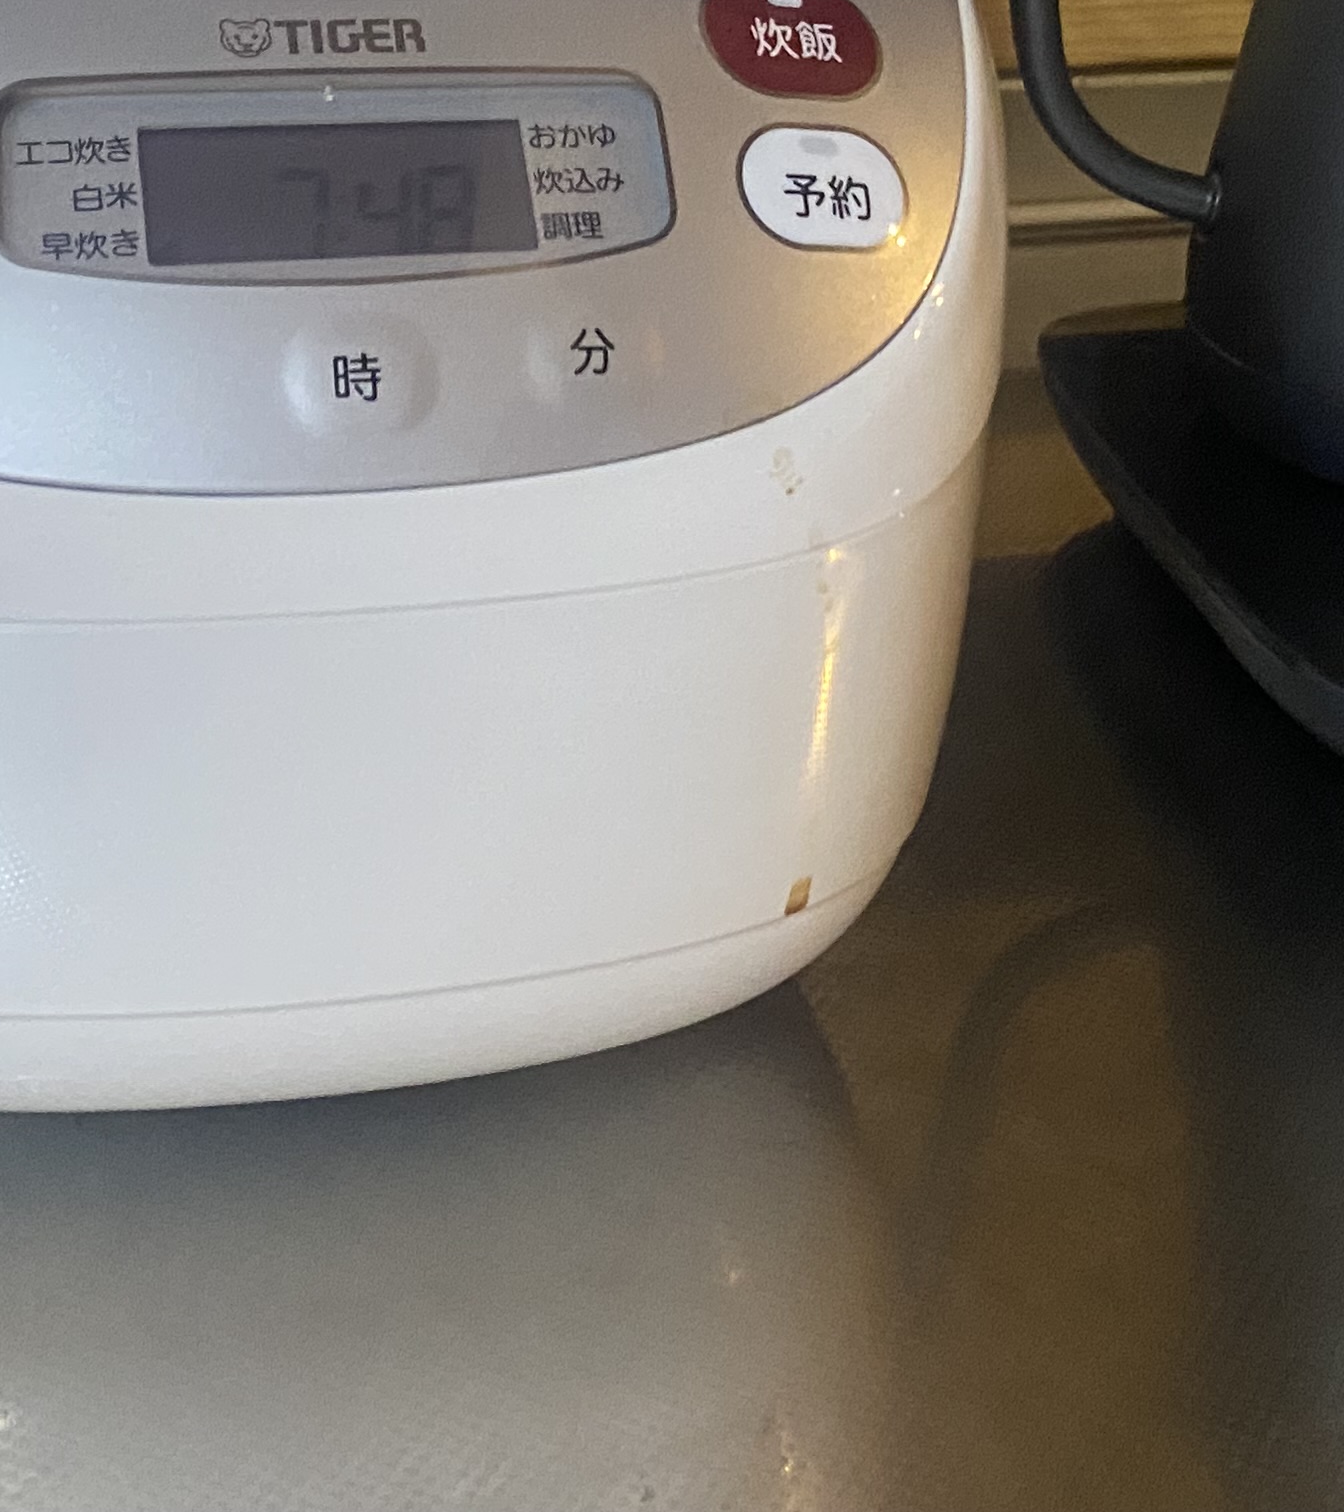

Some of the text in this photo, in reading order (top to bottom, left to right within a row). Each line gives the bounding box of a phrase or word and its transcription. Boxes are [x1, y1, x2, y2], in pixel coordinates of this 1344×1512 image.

[275, 17, 427, 55] TIGER
[749, 16, 844, 63] 炊飯
[16, 135, 132, 167] エコ炊き
[528, 122, 617, 149] おかゆ
[533, 166, 625, 194] 炊込み
[73, 182, 138, 212] 白米
[784, 174, 873, 220] 予約
[541, 211, 604, 241] 調理
[41, 230, 140, 261] 早炊き
[570, 327, 615, 375] 分
[332, 352, 382, 402] 時
